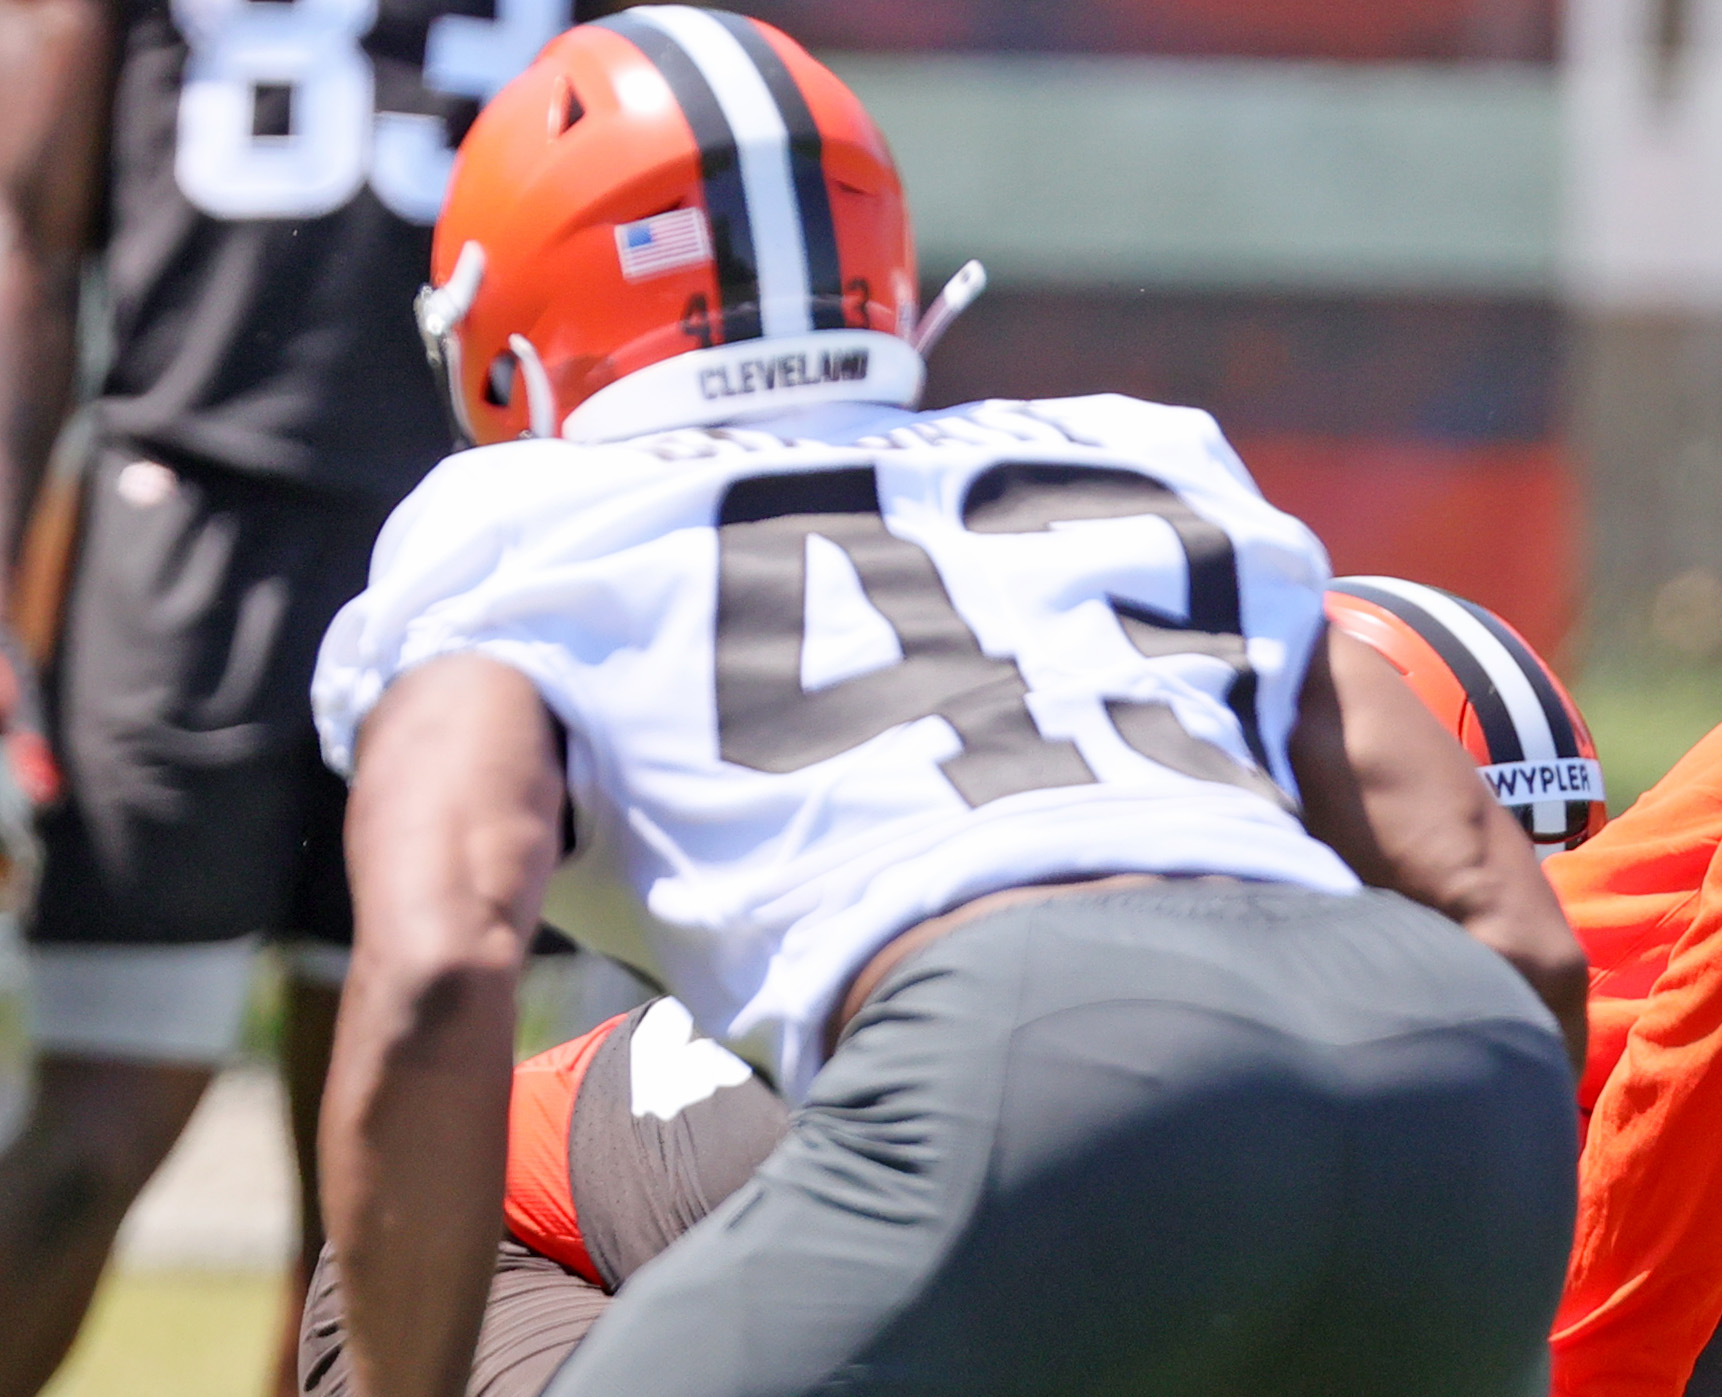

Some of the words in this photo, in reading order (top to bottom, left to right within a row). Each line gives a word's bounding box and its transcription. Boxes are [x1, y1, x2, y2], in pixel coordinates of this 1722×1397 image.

[700, 348, 870, 398] CLEVELAND
[714, 459, 1300, 812] 43
[1484, 763, 1592, 798] WYPLER
